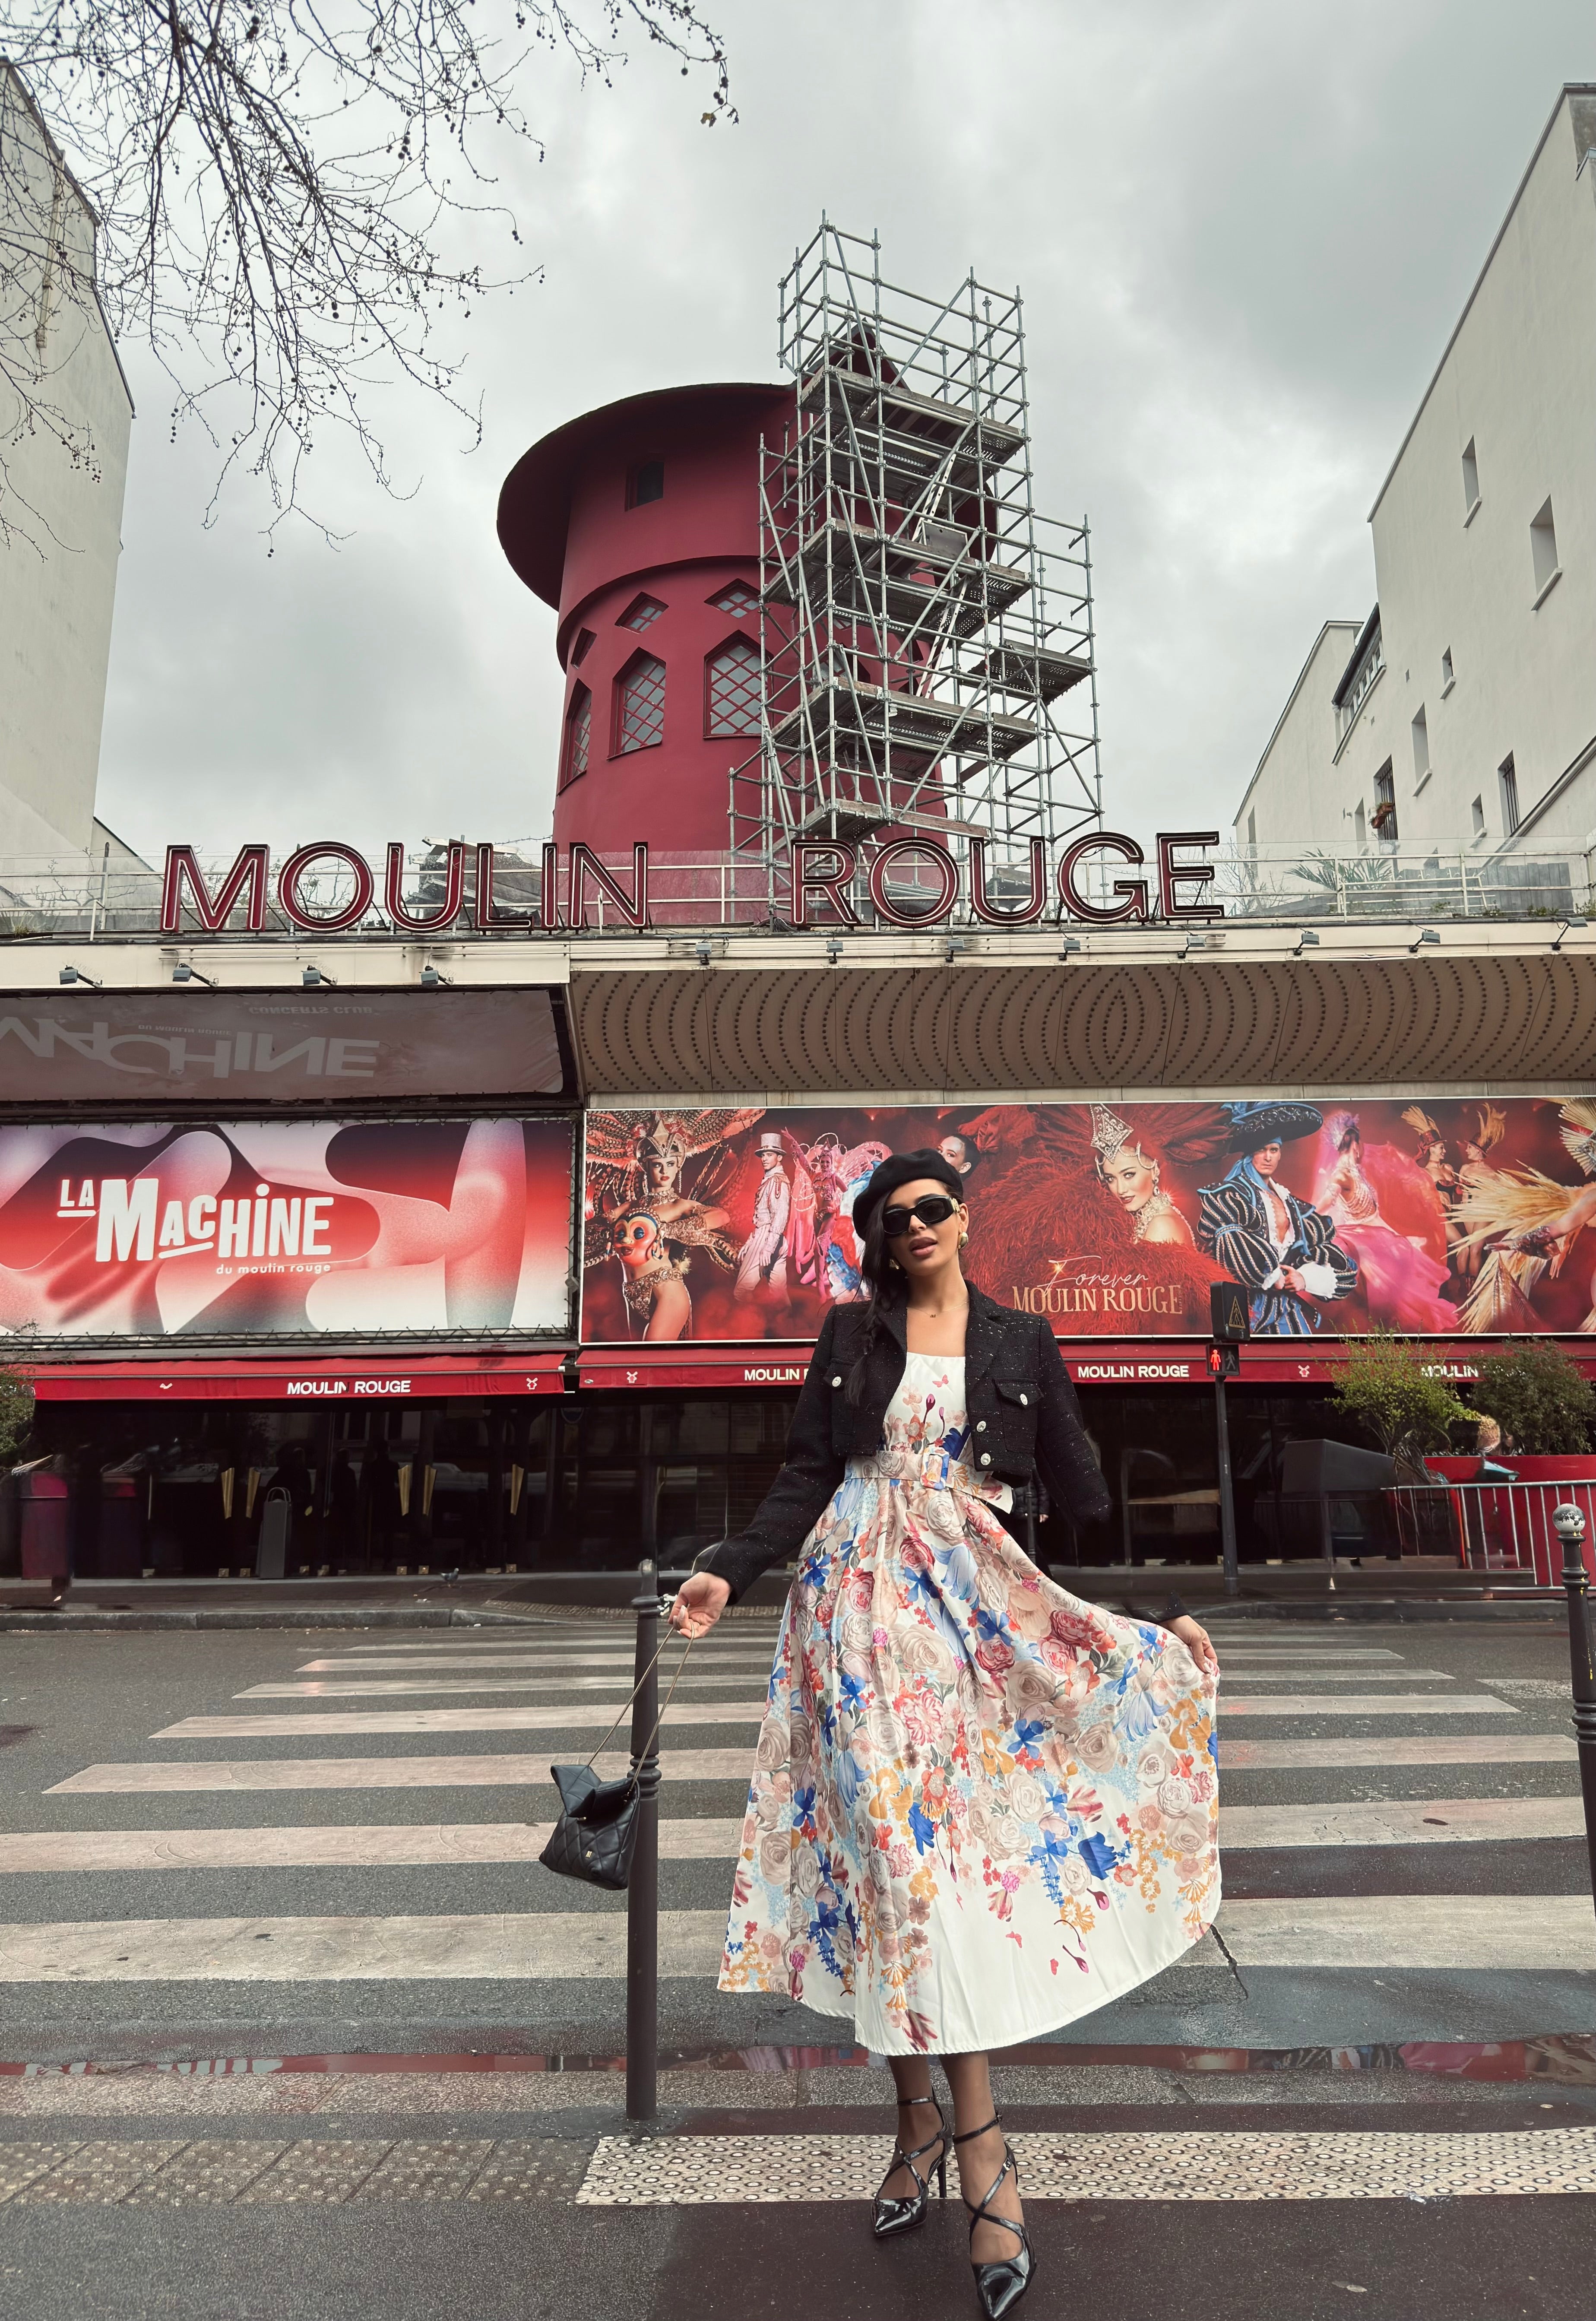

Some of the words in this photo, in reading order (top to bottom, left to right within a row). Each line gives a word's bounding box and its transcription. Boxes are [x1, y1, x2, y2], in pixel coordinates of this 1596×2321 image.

[160, 841, 649, 934] MOULIN
[791, 831, 1226, 928] ROUGE
[60, 1179, 95, 1207] LA
[216, 1264, 233, 1275] du
[238, 1263, 285, 1274] moulin
[290, 1264, 331, 1274] rouge
[1037, 1255, 1149, 1297] Forever
[1012, 1286, 1097, 1314] MOULIN
[1102, 1285, 1183, 1315] ROUGE
[744, 1368, 800, 1381] MOULIN
[1078, 1366, 1134, 1378] MOULIN
[1138, 1365, 1190, 1377] ROUGE
[287, 1382, 349, 1395] MOULIN
[354, 1380, 412, 1394] ROUGE
